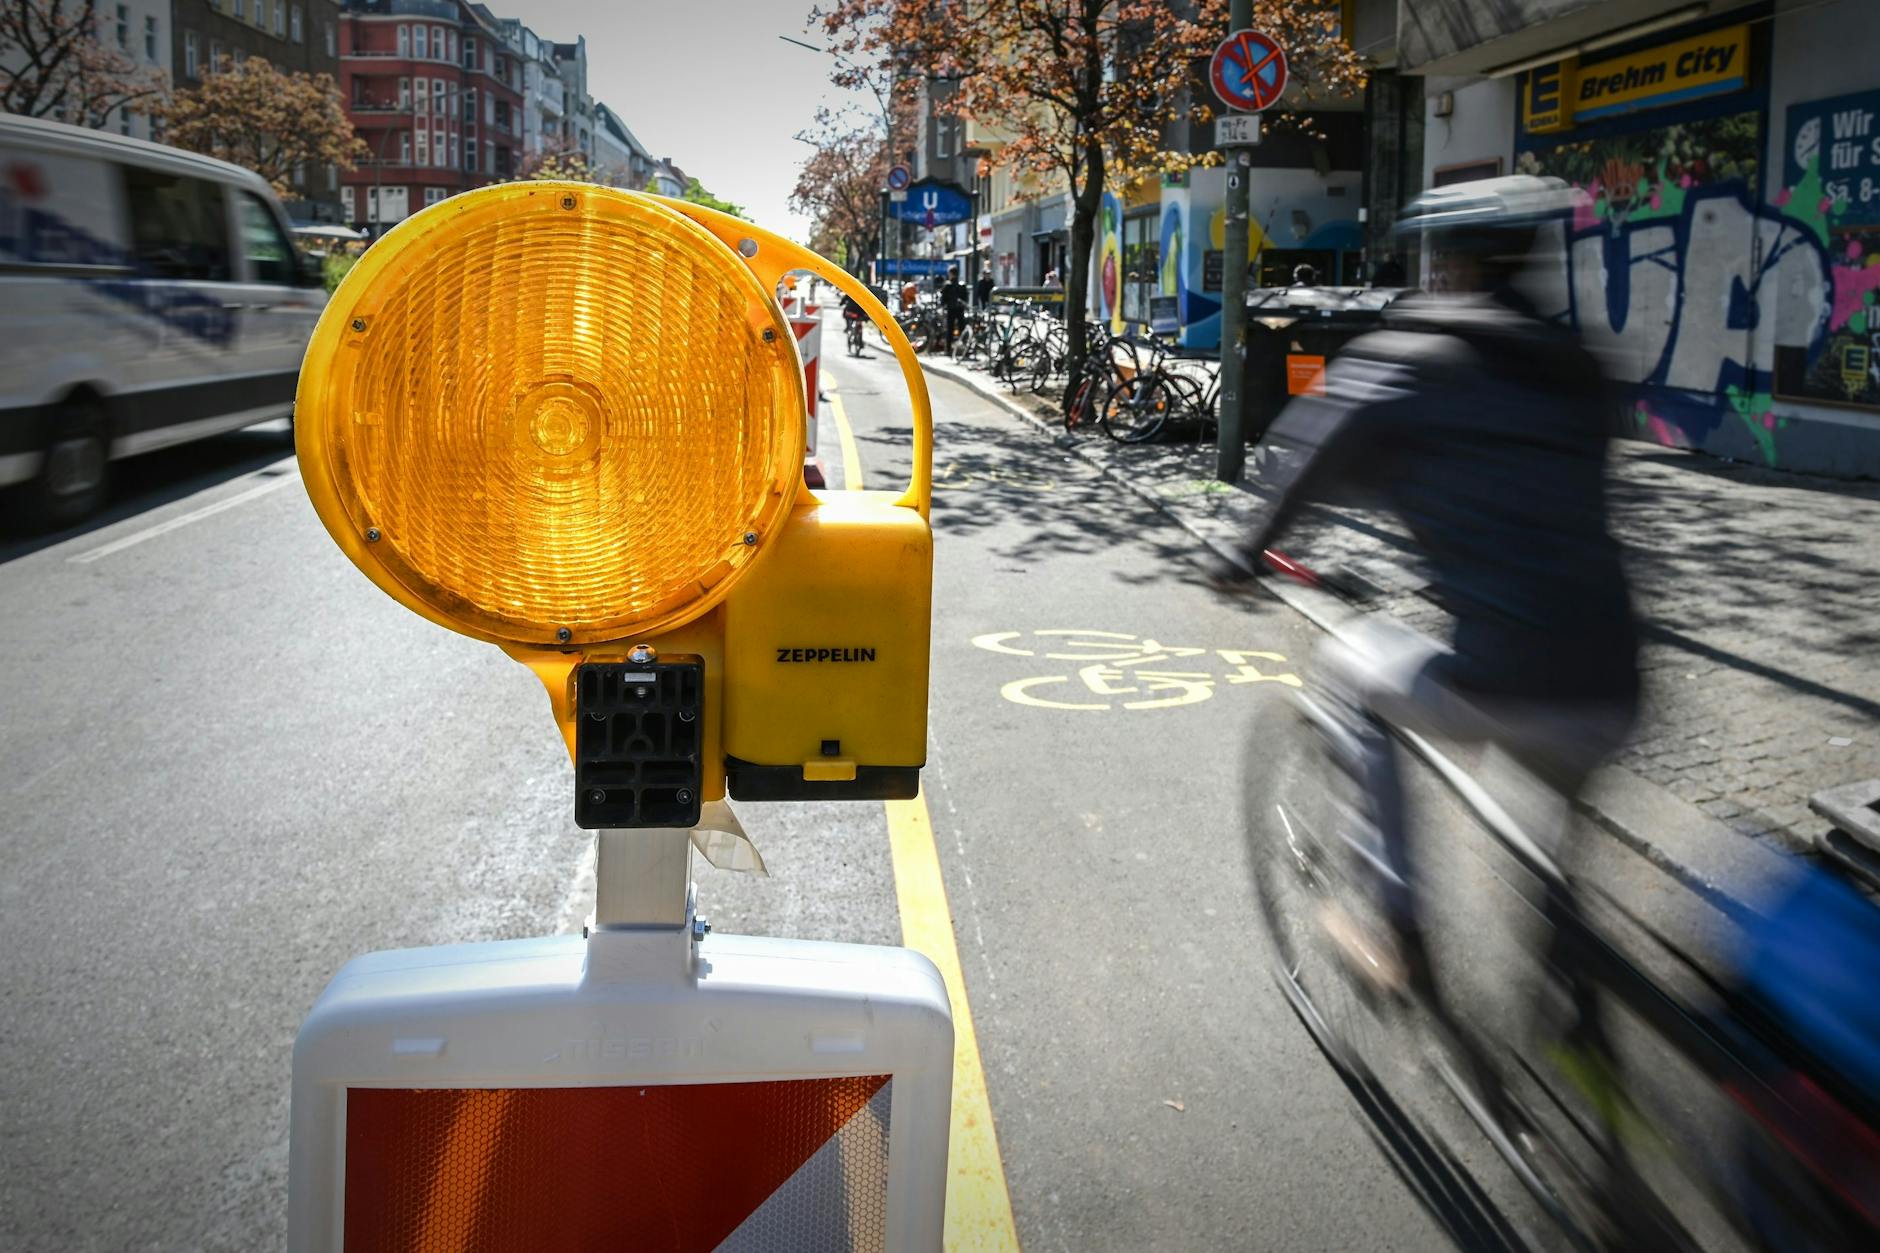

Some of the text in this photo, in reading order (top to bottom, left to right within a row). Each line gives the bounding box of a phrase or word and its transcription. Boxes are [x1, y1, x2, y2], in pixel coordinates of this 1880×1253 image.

[1580, 44, 1738, 100] Brehm City
[1832, 109, 1874, 140] Wir
[1831, 141, 1864, 169] für
[923, 191, 938, 209] U
[776, 648, 876, 662] ZEPPELIN
